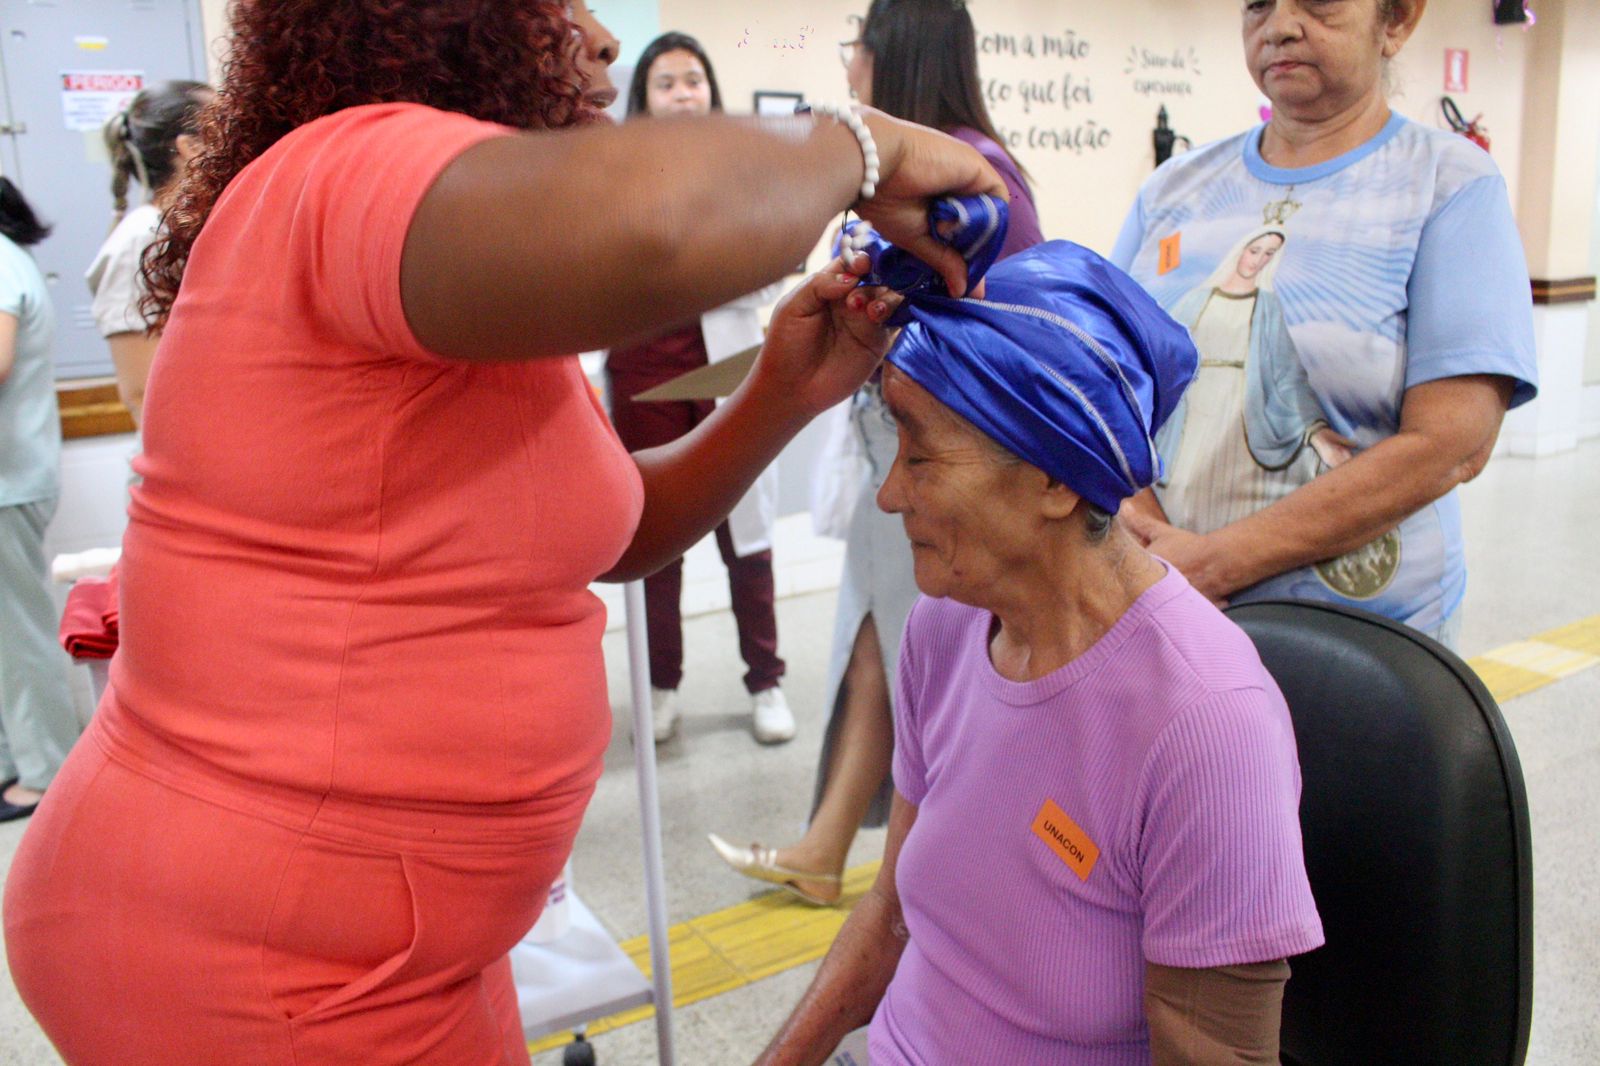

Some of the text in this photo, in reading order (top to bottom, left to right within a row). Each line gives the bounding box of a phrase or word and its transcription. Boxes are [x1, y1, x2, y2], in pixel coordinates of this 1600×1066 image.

[975, 29, 1090, 60] om a mão
[69, 74, 136, 90] PERIGO
[982, 73, 1093, 114] ço que foi
[1043, 820, 1085, 864] UNACON
